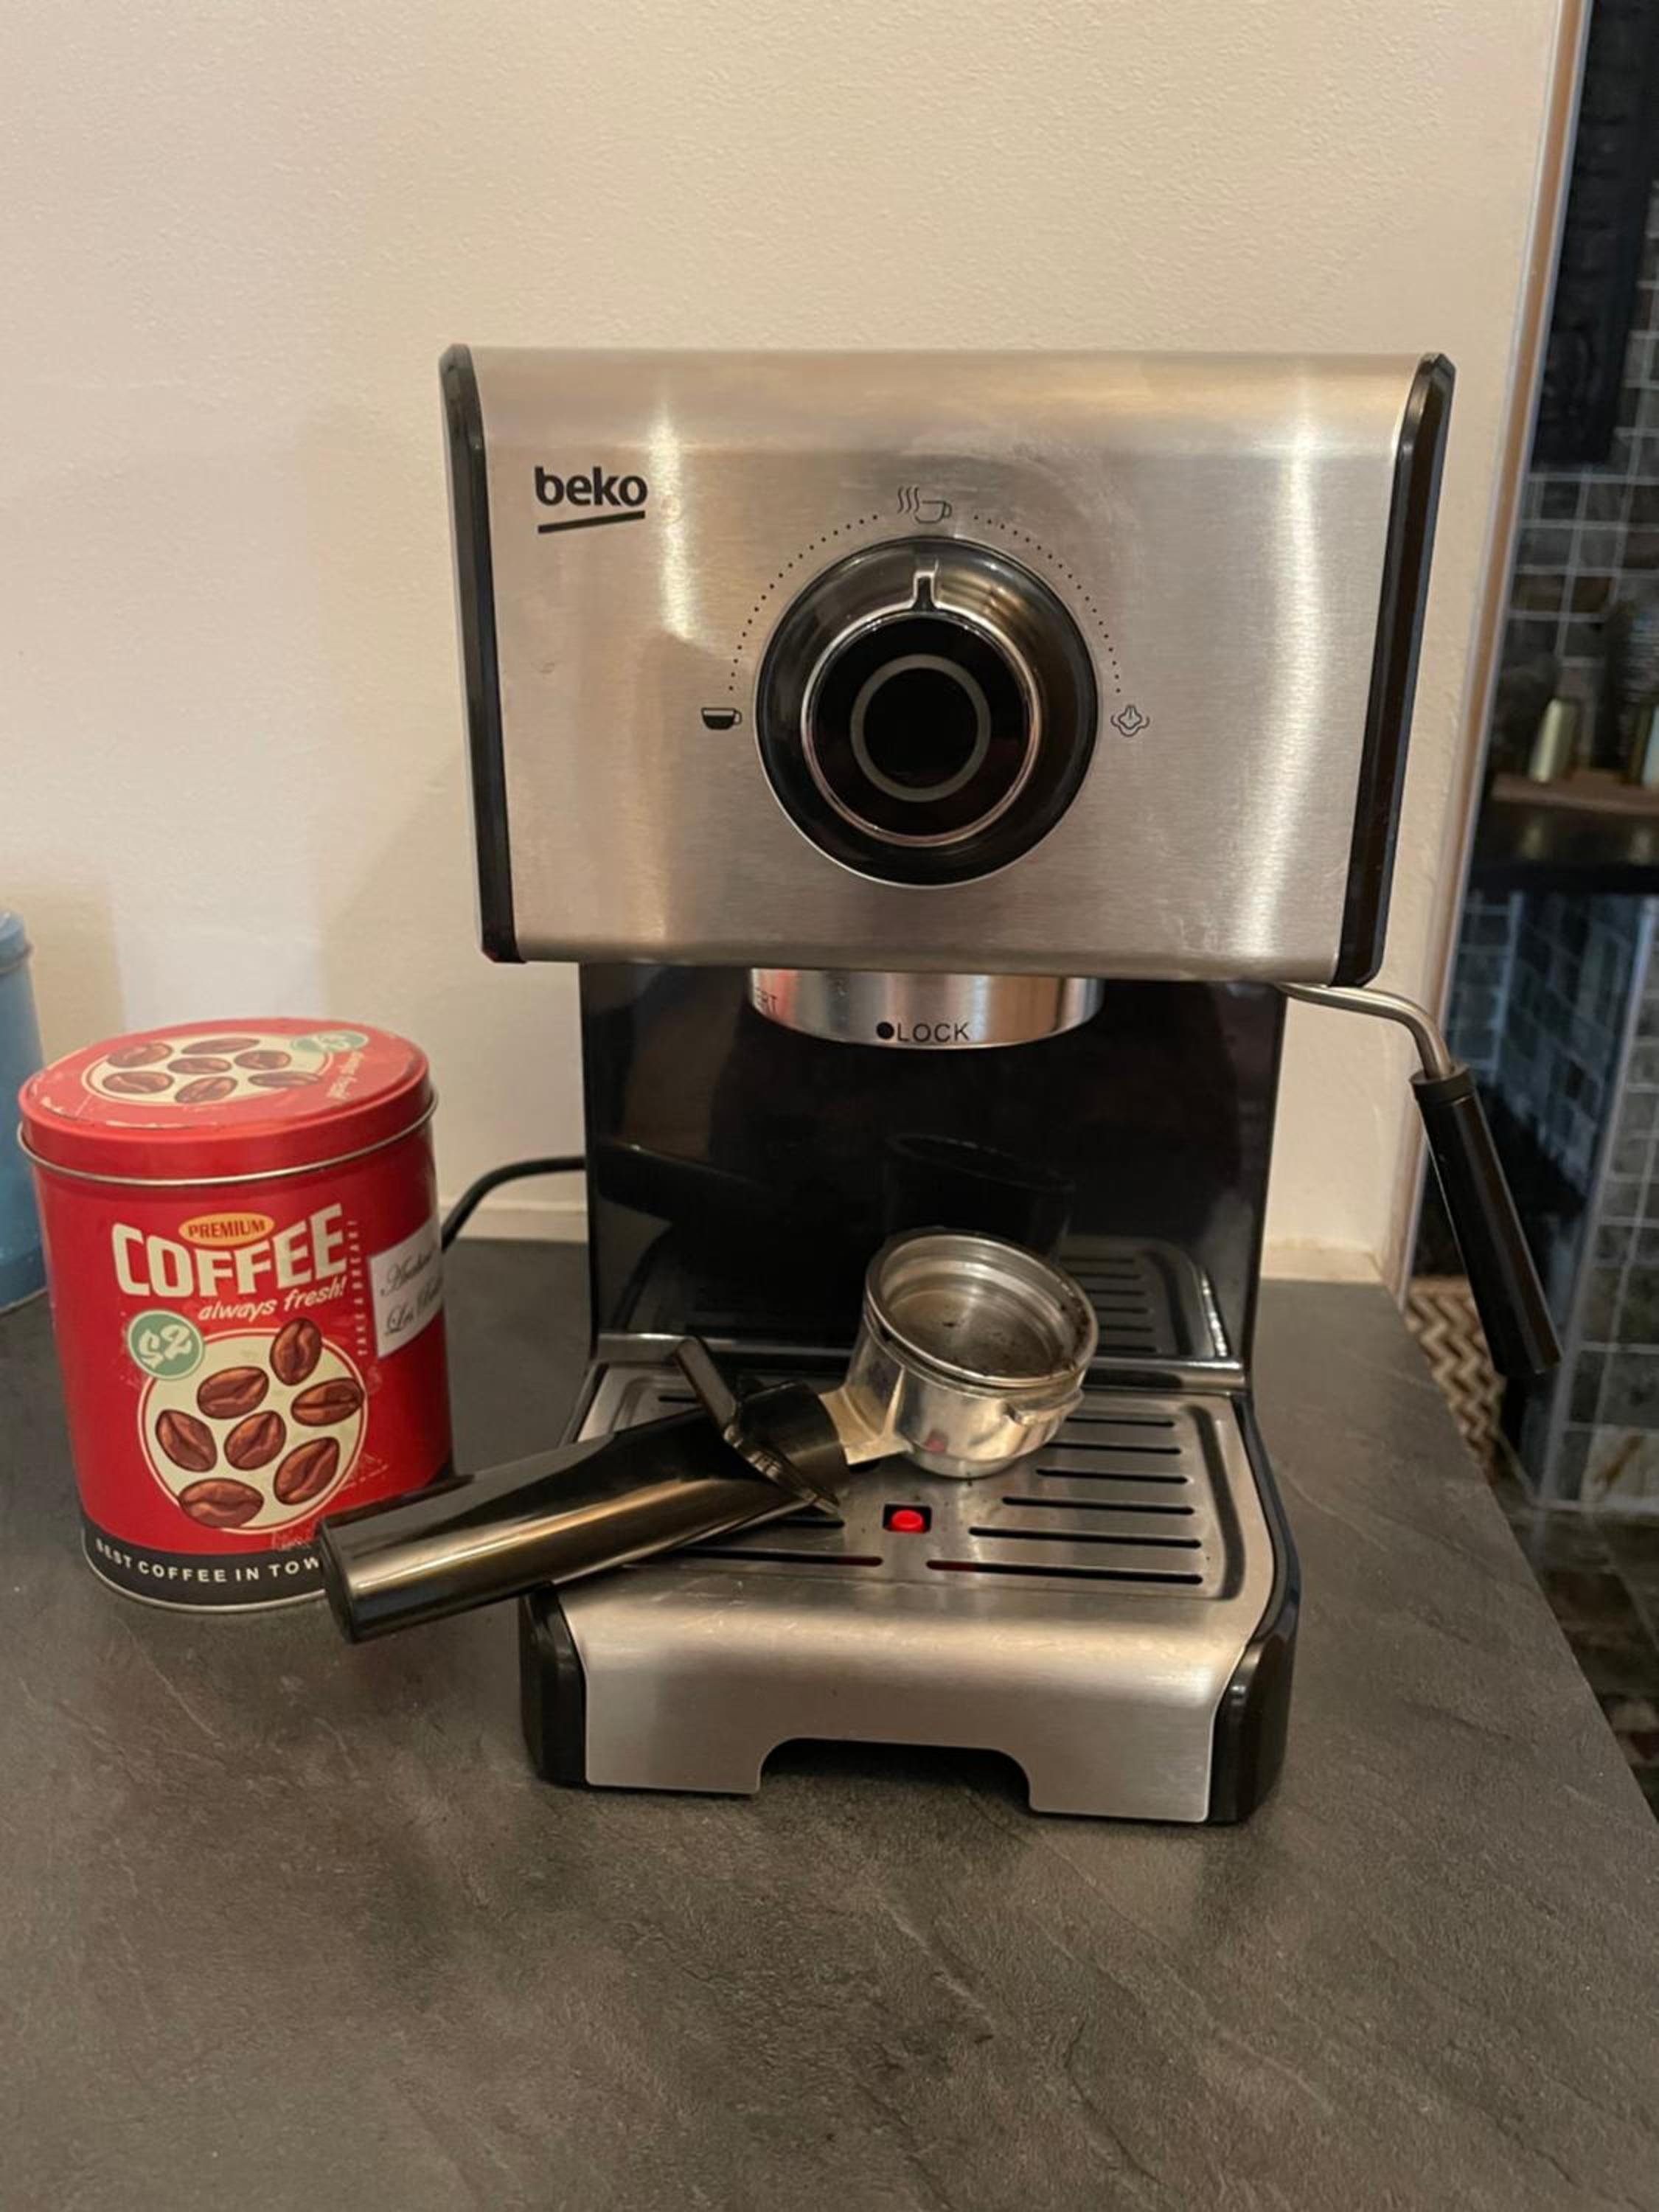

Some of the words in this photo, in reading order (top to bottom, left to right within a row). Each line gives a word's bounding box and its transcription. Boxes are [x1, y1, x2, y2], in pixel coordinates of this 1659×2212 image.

[535, 466, 647, 507] beko
[896, 1022, 970, 1043] LOCK
[187, 1218, 267, 1239] PREMIUM
[112, 1203, 347, 1298] COFFEE
[198, 1298, 277, 1323] always
[283, 1275, 347, 1311] fresh!
[96, 1538, 132, 1568] BEST
[138, 1559, 226, 1582] COFFEE
[235, 1568, 260, 1582] IN
[268, 1557, 320, 1577] TOW
